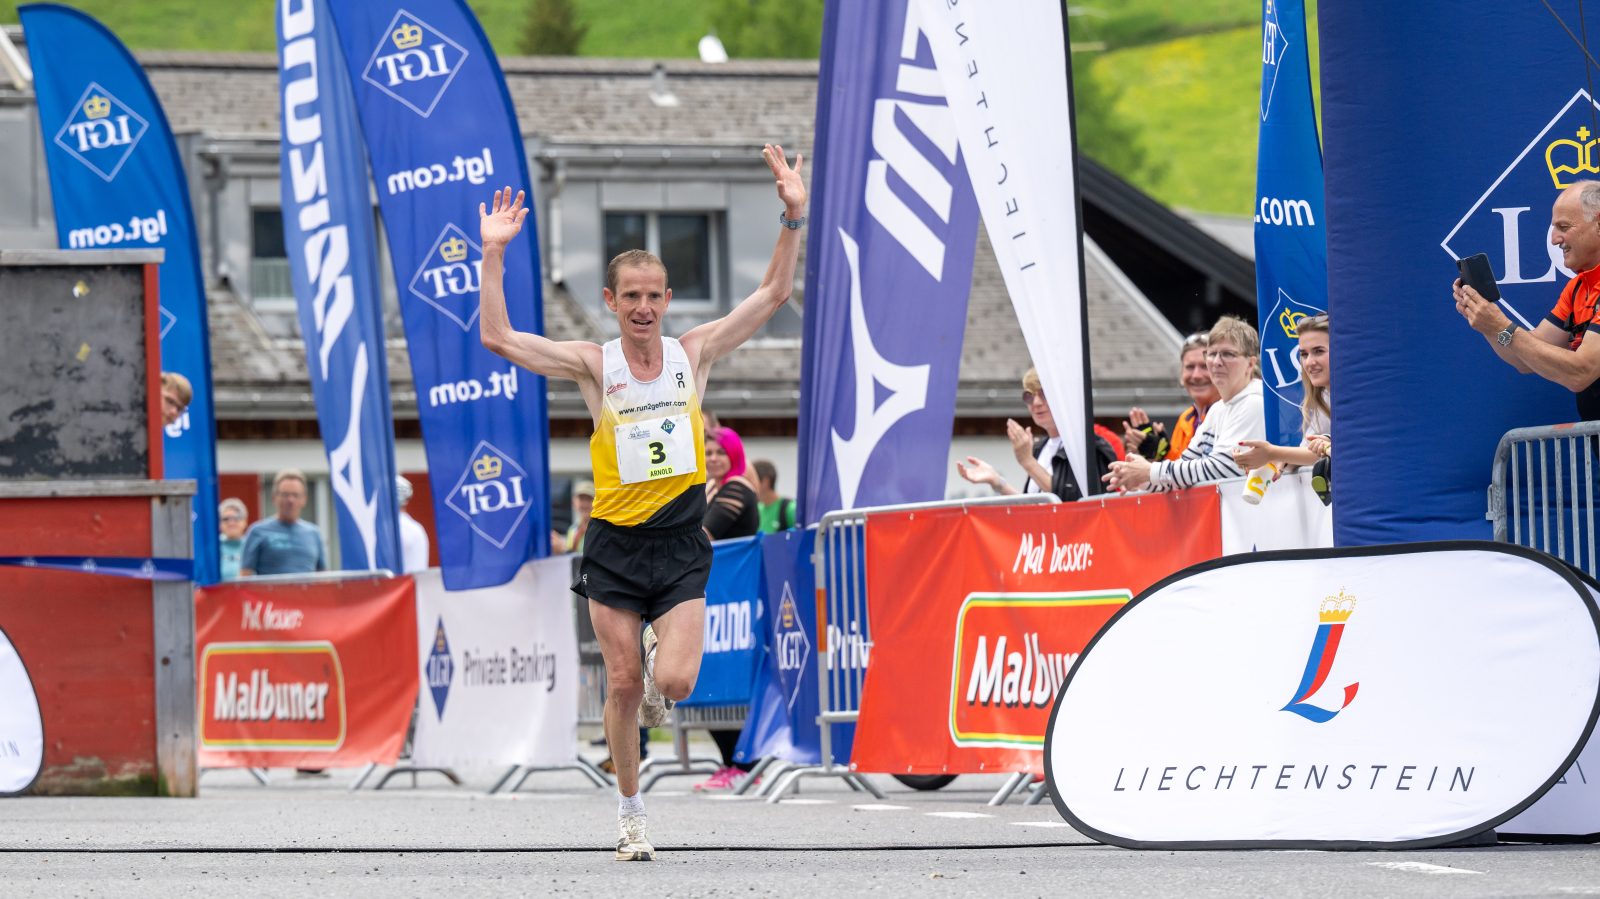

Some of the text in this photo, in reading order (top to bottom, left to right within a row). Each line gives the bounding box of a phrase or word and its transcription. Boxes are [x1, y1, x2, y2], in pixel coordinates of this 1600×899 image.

[1262, 20, 1277, 66] GT
[1253, 196, 1315, 226] .com
[618, 400, 687, 415] www.run2gether.com
[648, 441, 666, 464] 3
[650, 467, 673, 477] ARNOLD
[1012, 532, 1094, 575] Mal besser:
[703, 600, 751, 653] IZUNO
[776, 631, 803, 670] LGT
[213, 669, 330, 722] Malbuner
[1113, 764, 1475, 792] LIECHTENSTEIN
